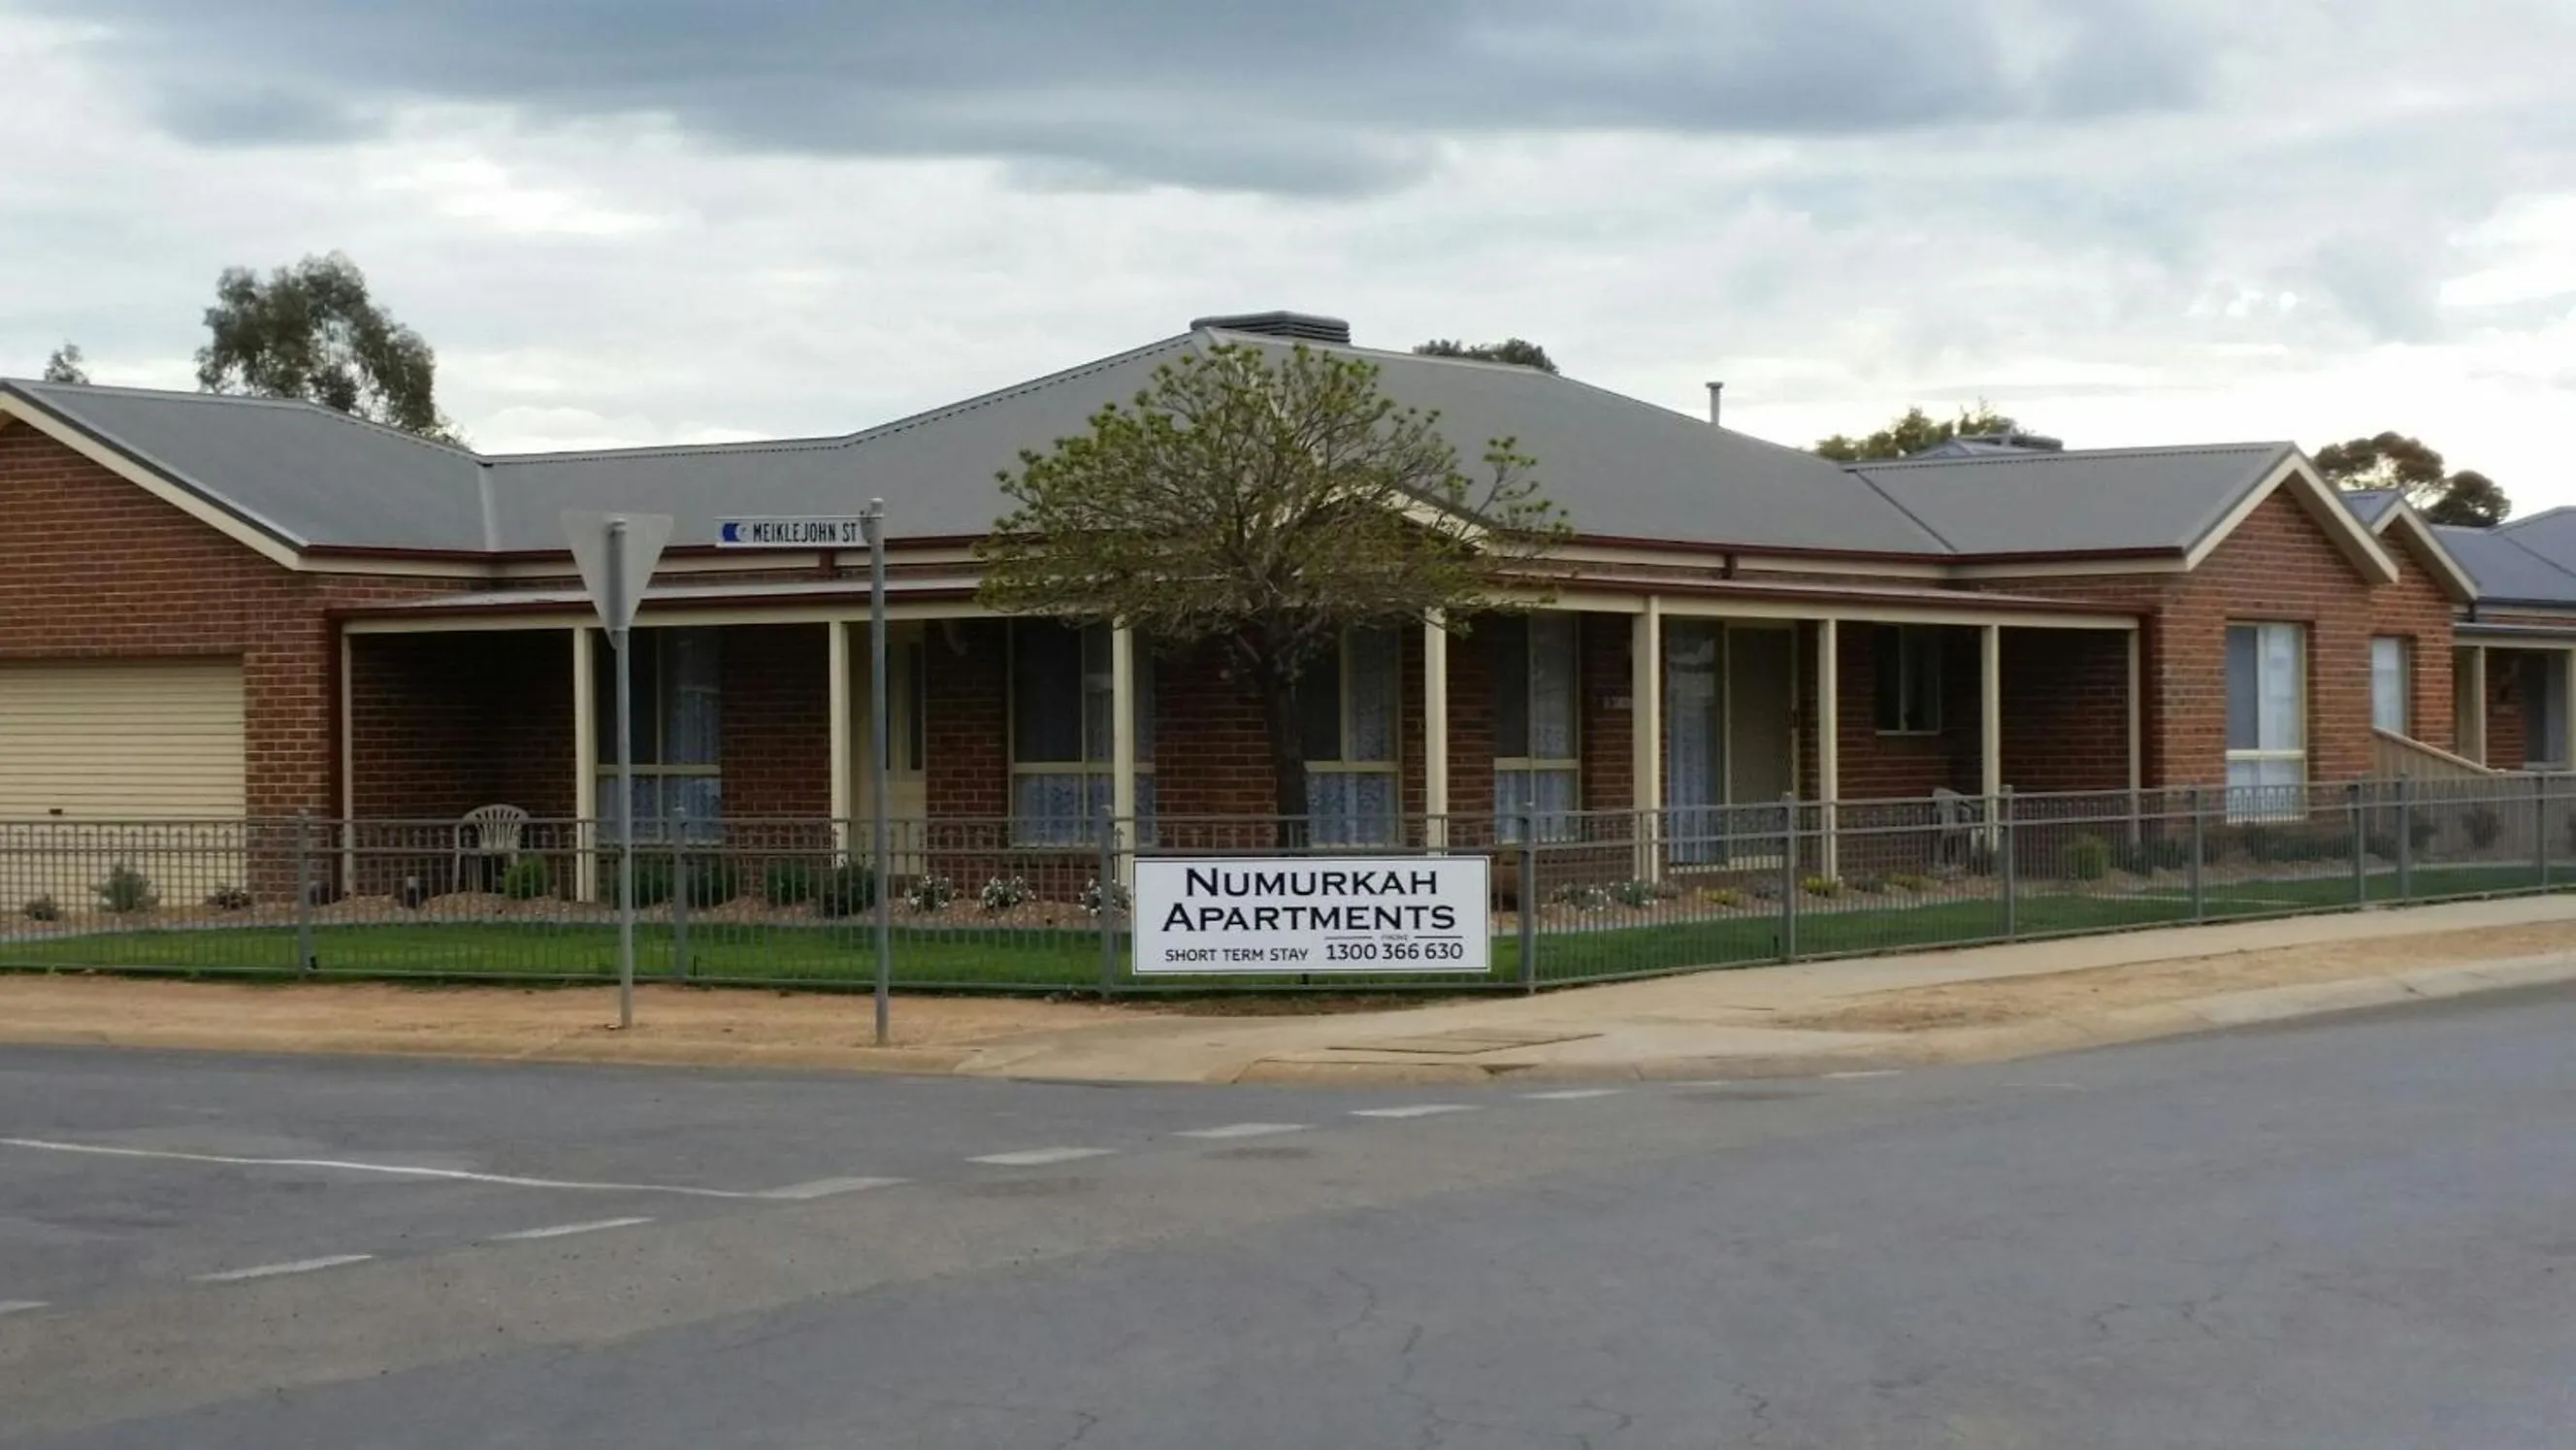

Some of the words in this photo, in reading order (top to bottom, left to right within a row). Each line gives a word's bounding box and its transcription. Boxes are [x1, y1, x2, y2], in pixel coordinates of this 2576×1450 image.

[754, 523, 835, 542] MEIKLEJOHN
[843, 523, 857, 542] ST
[1187, 868, 1436, 897] NUMURKAH
[1162, 903, 1454, 932] APARTMENTS
[1166, 949, 1217, 962] SHORT
[1223, 948, 1263, 961] TERM
[1270, 948, 1308, 961] STAY
[1326, 943, 1377, 960] 1300
[1383, 943, 1418, 959] 366
[1425, 943, 1463, 959] 630
